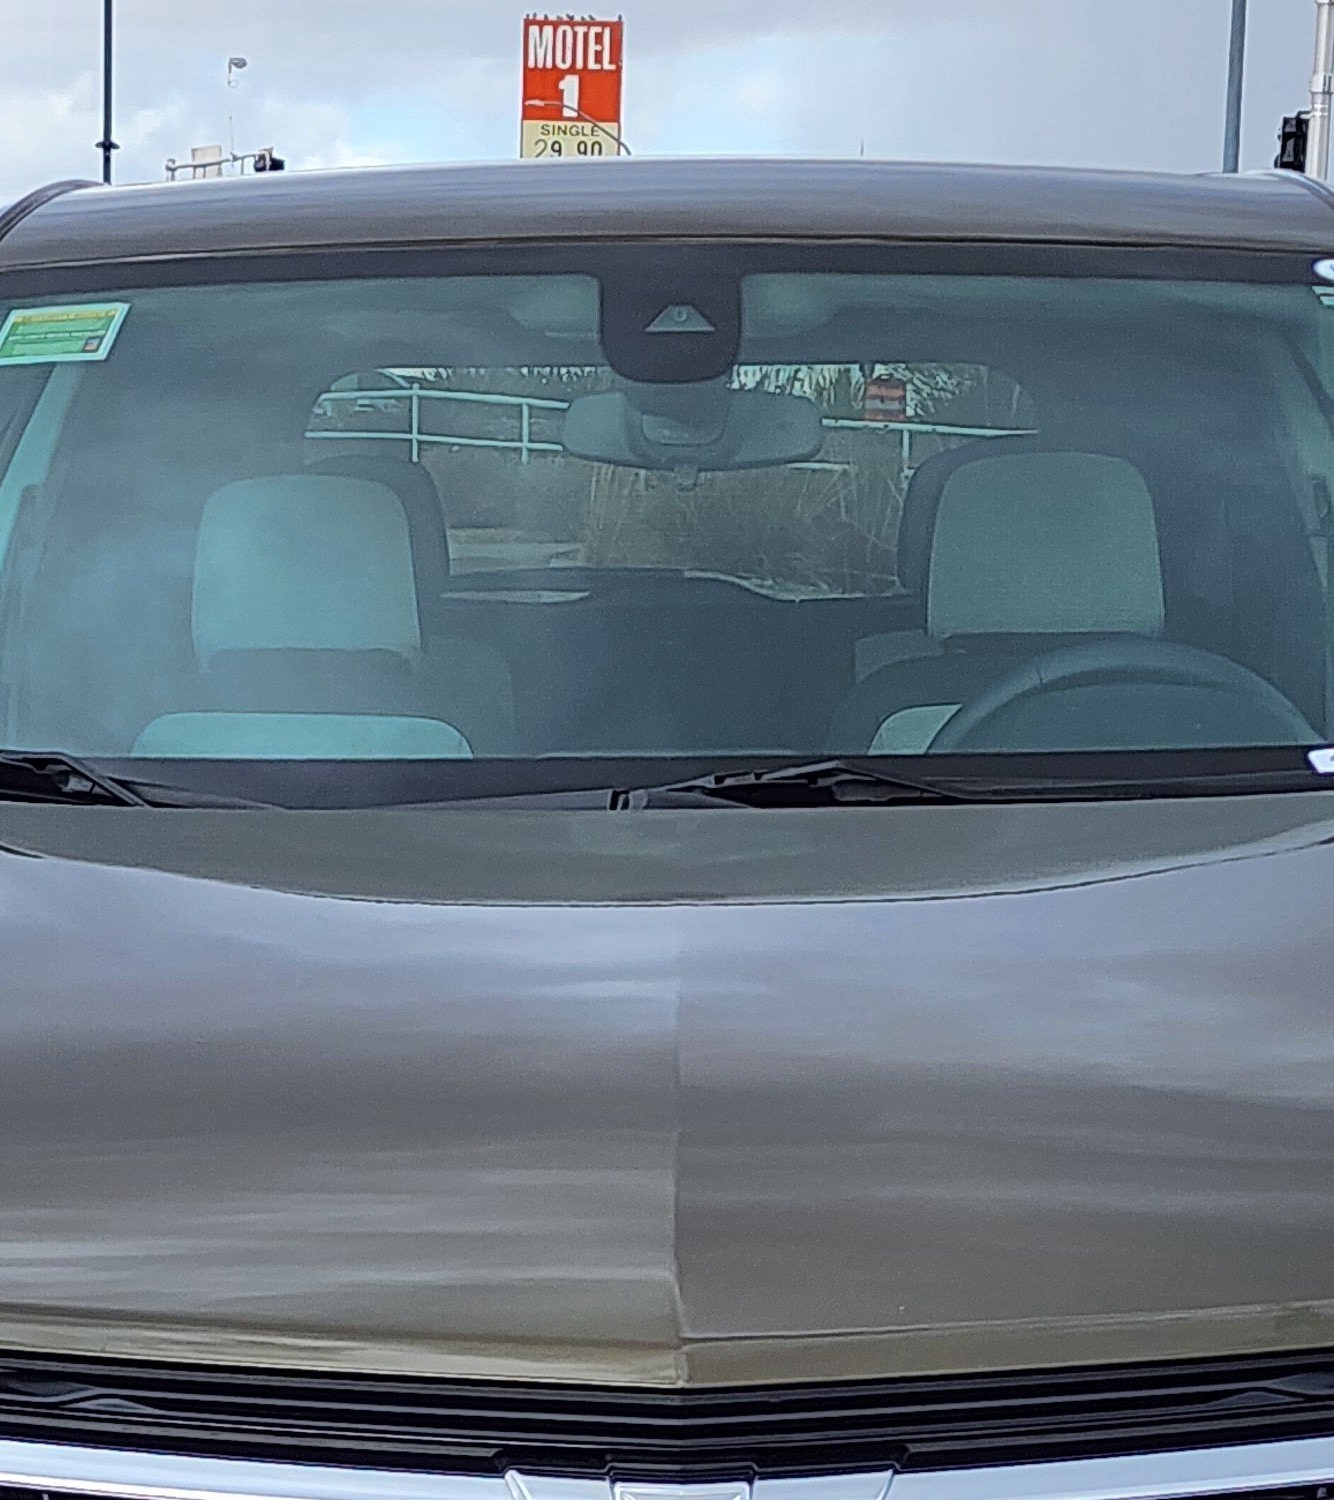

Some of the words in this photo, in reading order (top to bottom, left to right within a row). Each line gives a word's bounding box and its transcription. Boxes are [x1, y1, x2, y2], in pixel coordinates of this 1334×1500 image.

[527, 24, 617, 70] MOTEL
[558, 74, 579, 118] 1
[540, 124, 601, 137] SINGLE
